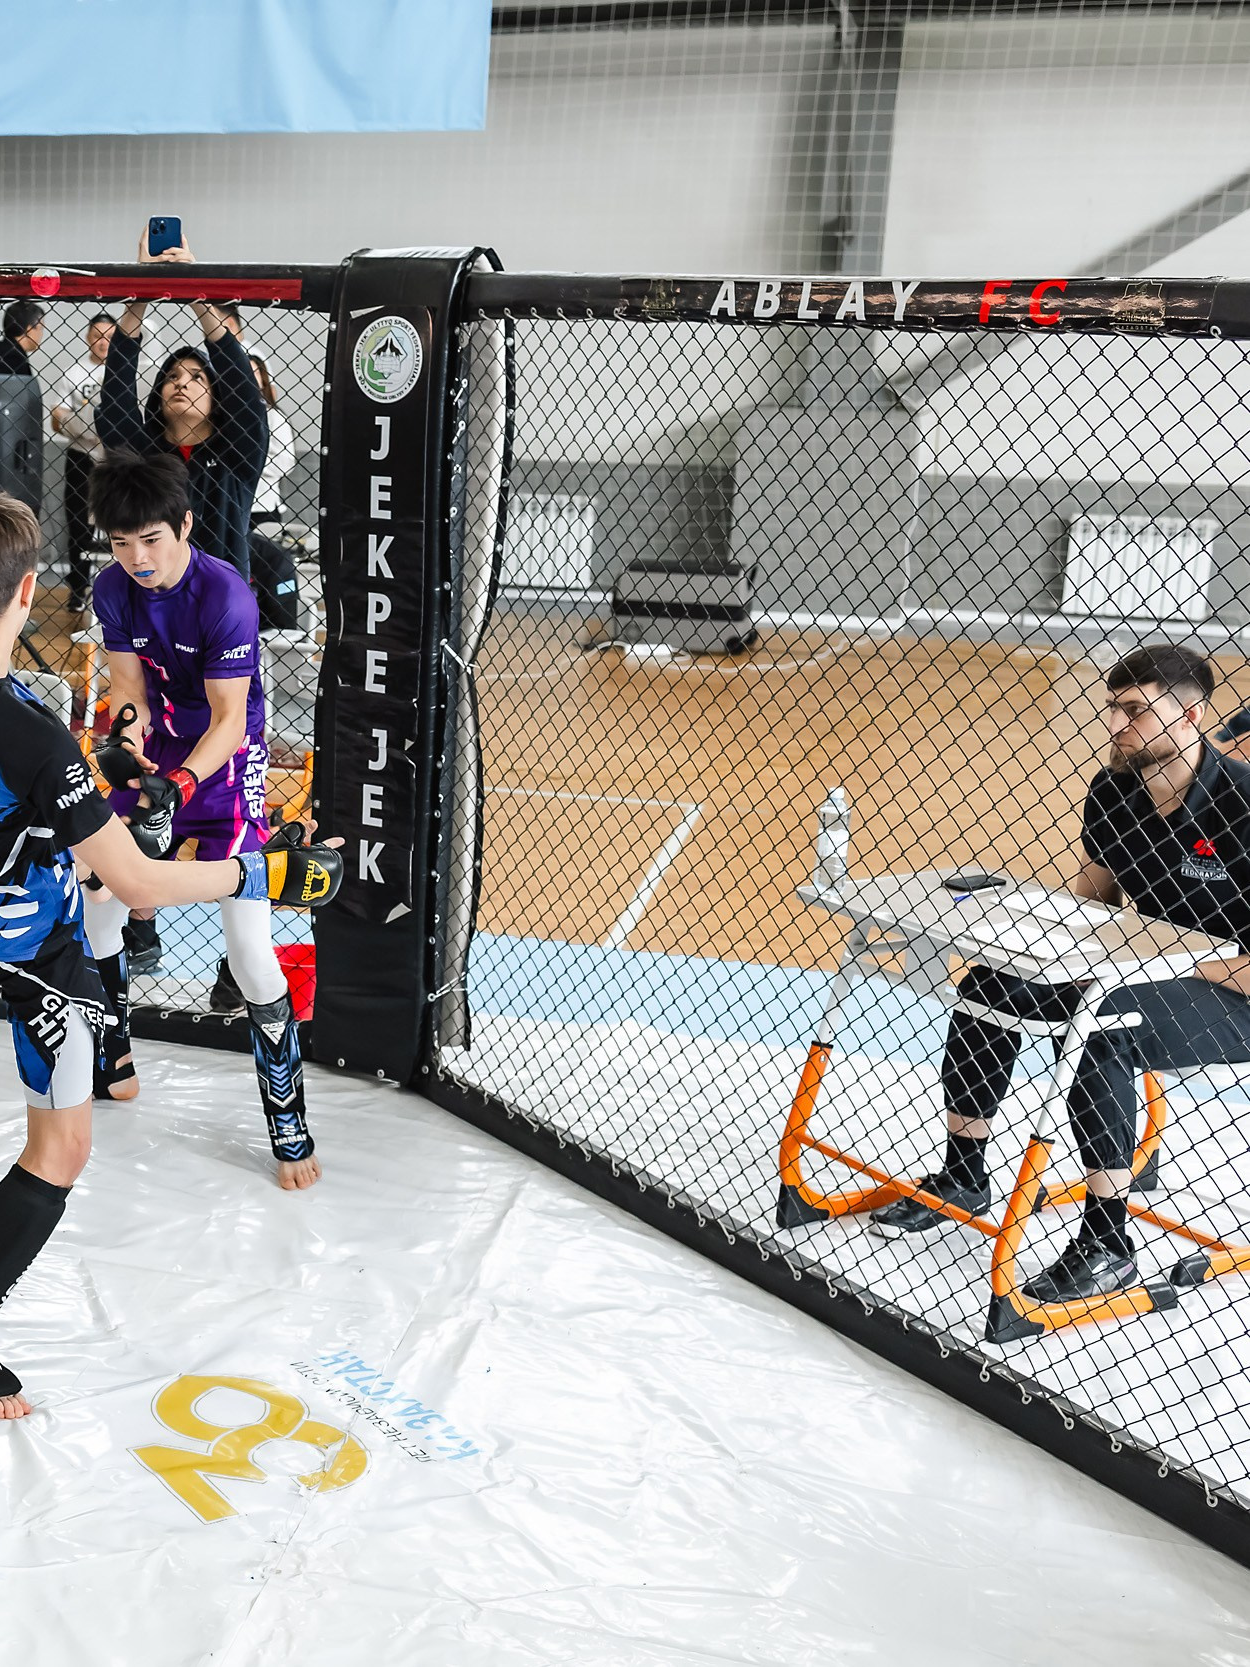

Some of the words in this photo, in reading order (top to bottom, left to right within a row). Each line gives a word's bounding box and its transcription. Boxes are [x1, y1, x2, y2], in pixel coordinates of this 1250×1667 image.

[710, 280, 922, 322] ABLAY
[978, 279, 1070, 324] FC
[393, 318, 412, 333] SPORT
[364, 415, 396, 695] JEKPE
[358, 728, 388, 884] JEK
[274, 1133, 307, 1146] IMMAF
